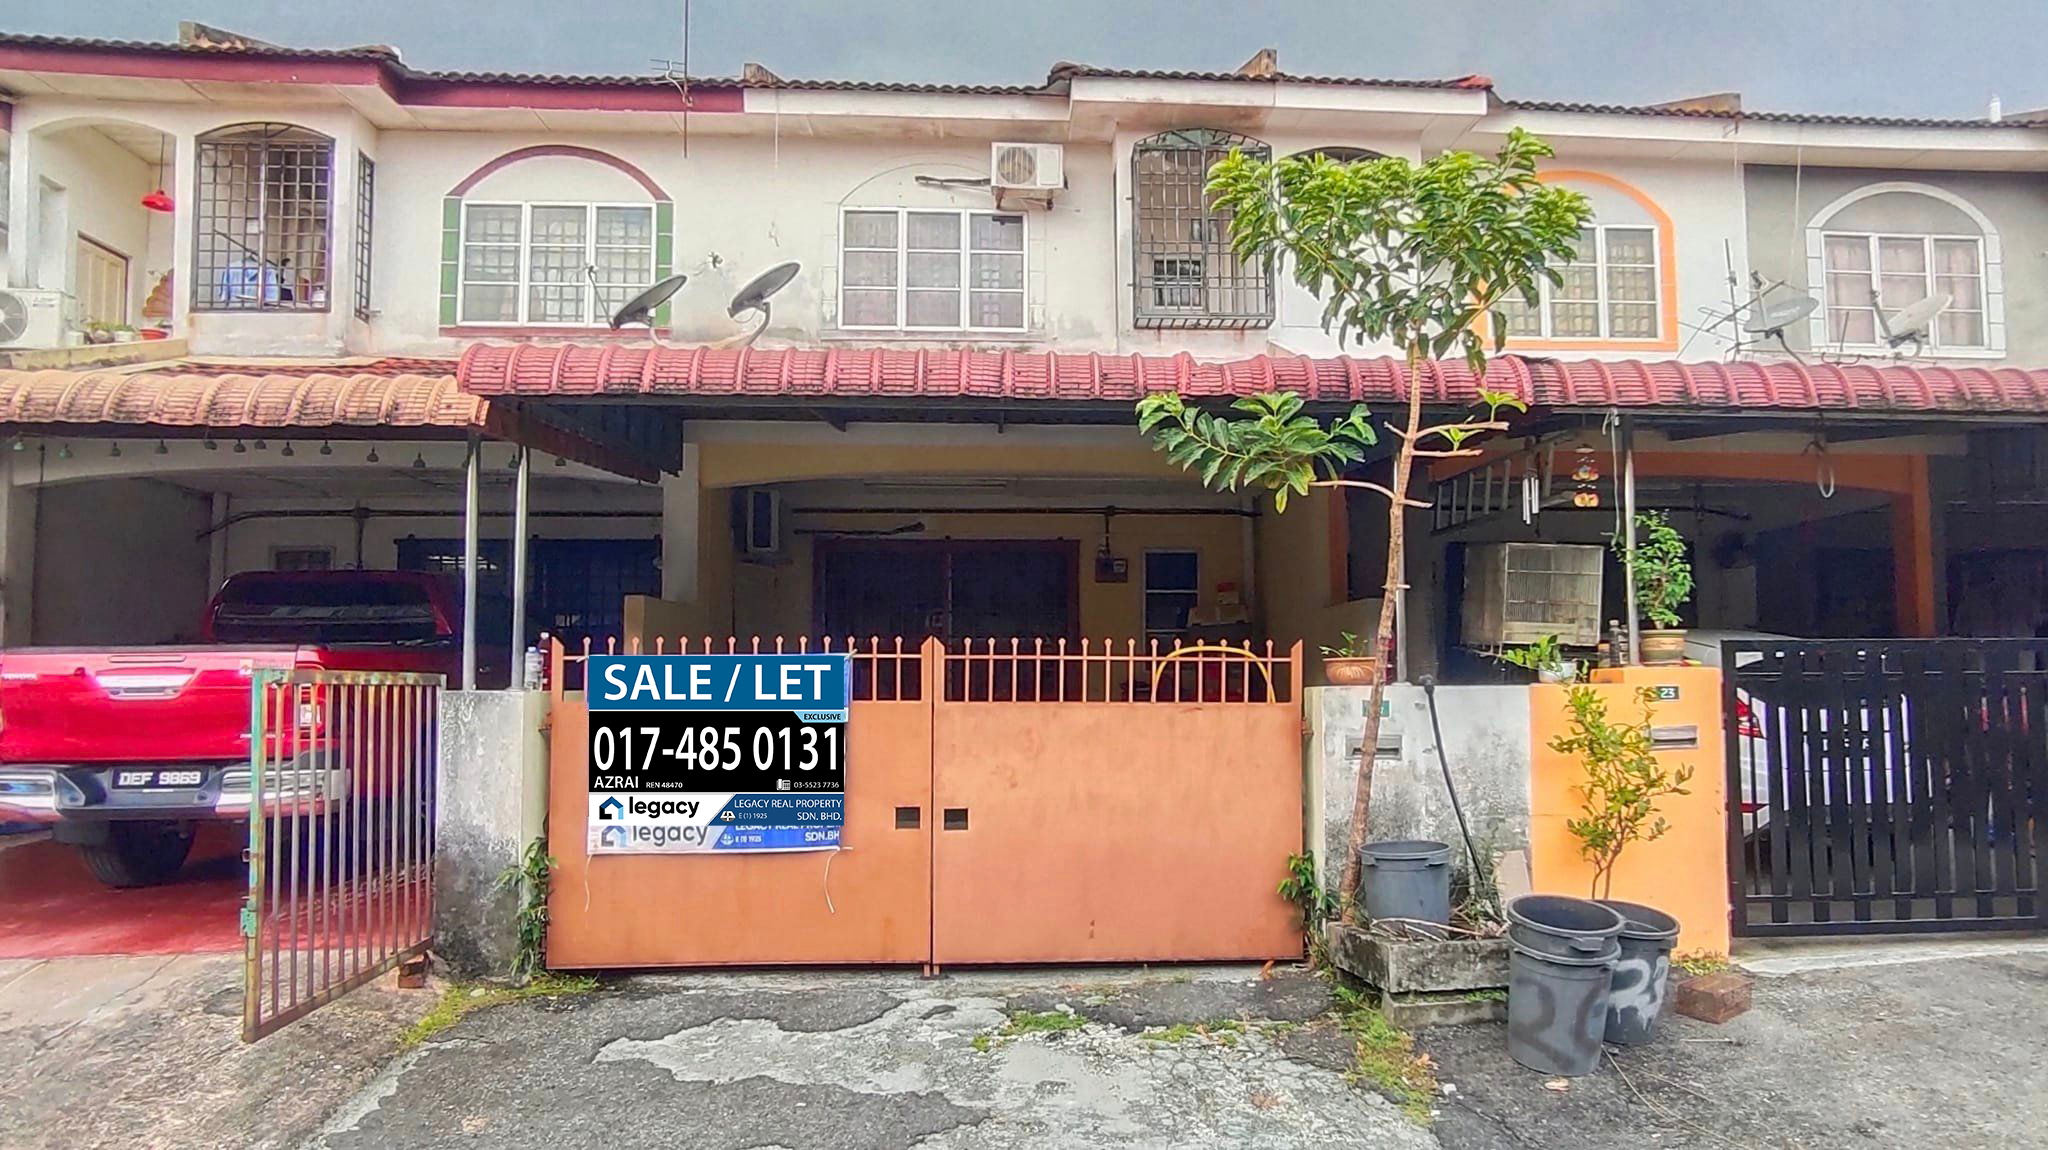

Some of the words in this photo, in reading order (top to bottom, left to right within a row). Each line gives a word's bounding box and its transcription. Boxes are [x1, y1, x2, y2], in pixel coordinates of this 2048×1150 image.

[604, 664, 712, 700] SALE
[724, 664, 742, 702] /
[755, 664, 831, 700] LET
[1660, 687, 1675, 699] 23
[594, 726, 741, 771] 017-485
[753, 726, 837, 771] 0131
[118, 771, 154, 785] DEF
[158, 771, 201, 785] 9869
[594, 775, 639, 788] AZRAI
[793, 781, 821, 789] 03-5523
[823, 781, 840, 789] 7736
[629, 796, 700, 818] legacy
[734, 799, 769, 808] LEGACY
[771, 799, 794, 808] REAL
[796, 799, 842, 808] PROPERTY
[738, 812, 743, 820] E
[753, 812, 768, 820] 1925
[797, 811, 818, 821] SDN.
[820, 811, 843, 821] BHD.
[632, 826, 708, 847] legacy
